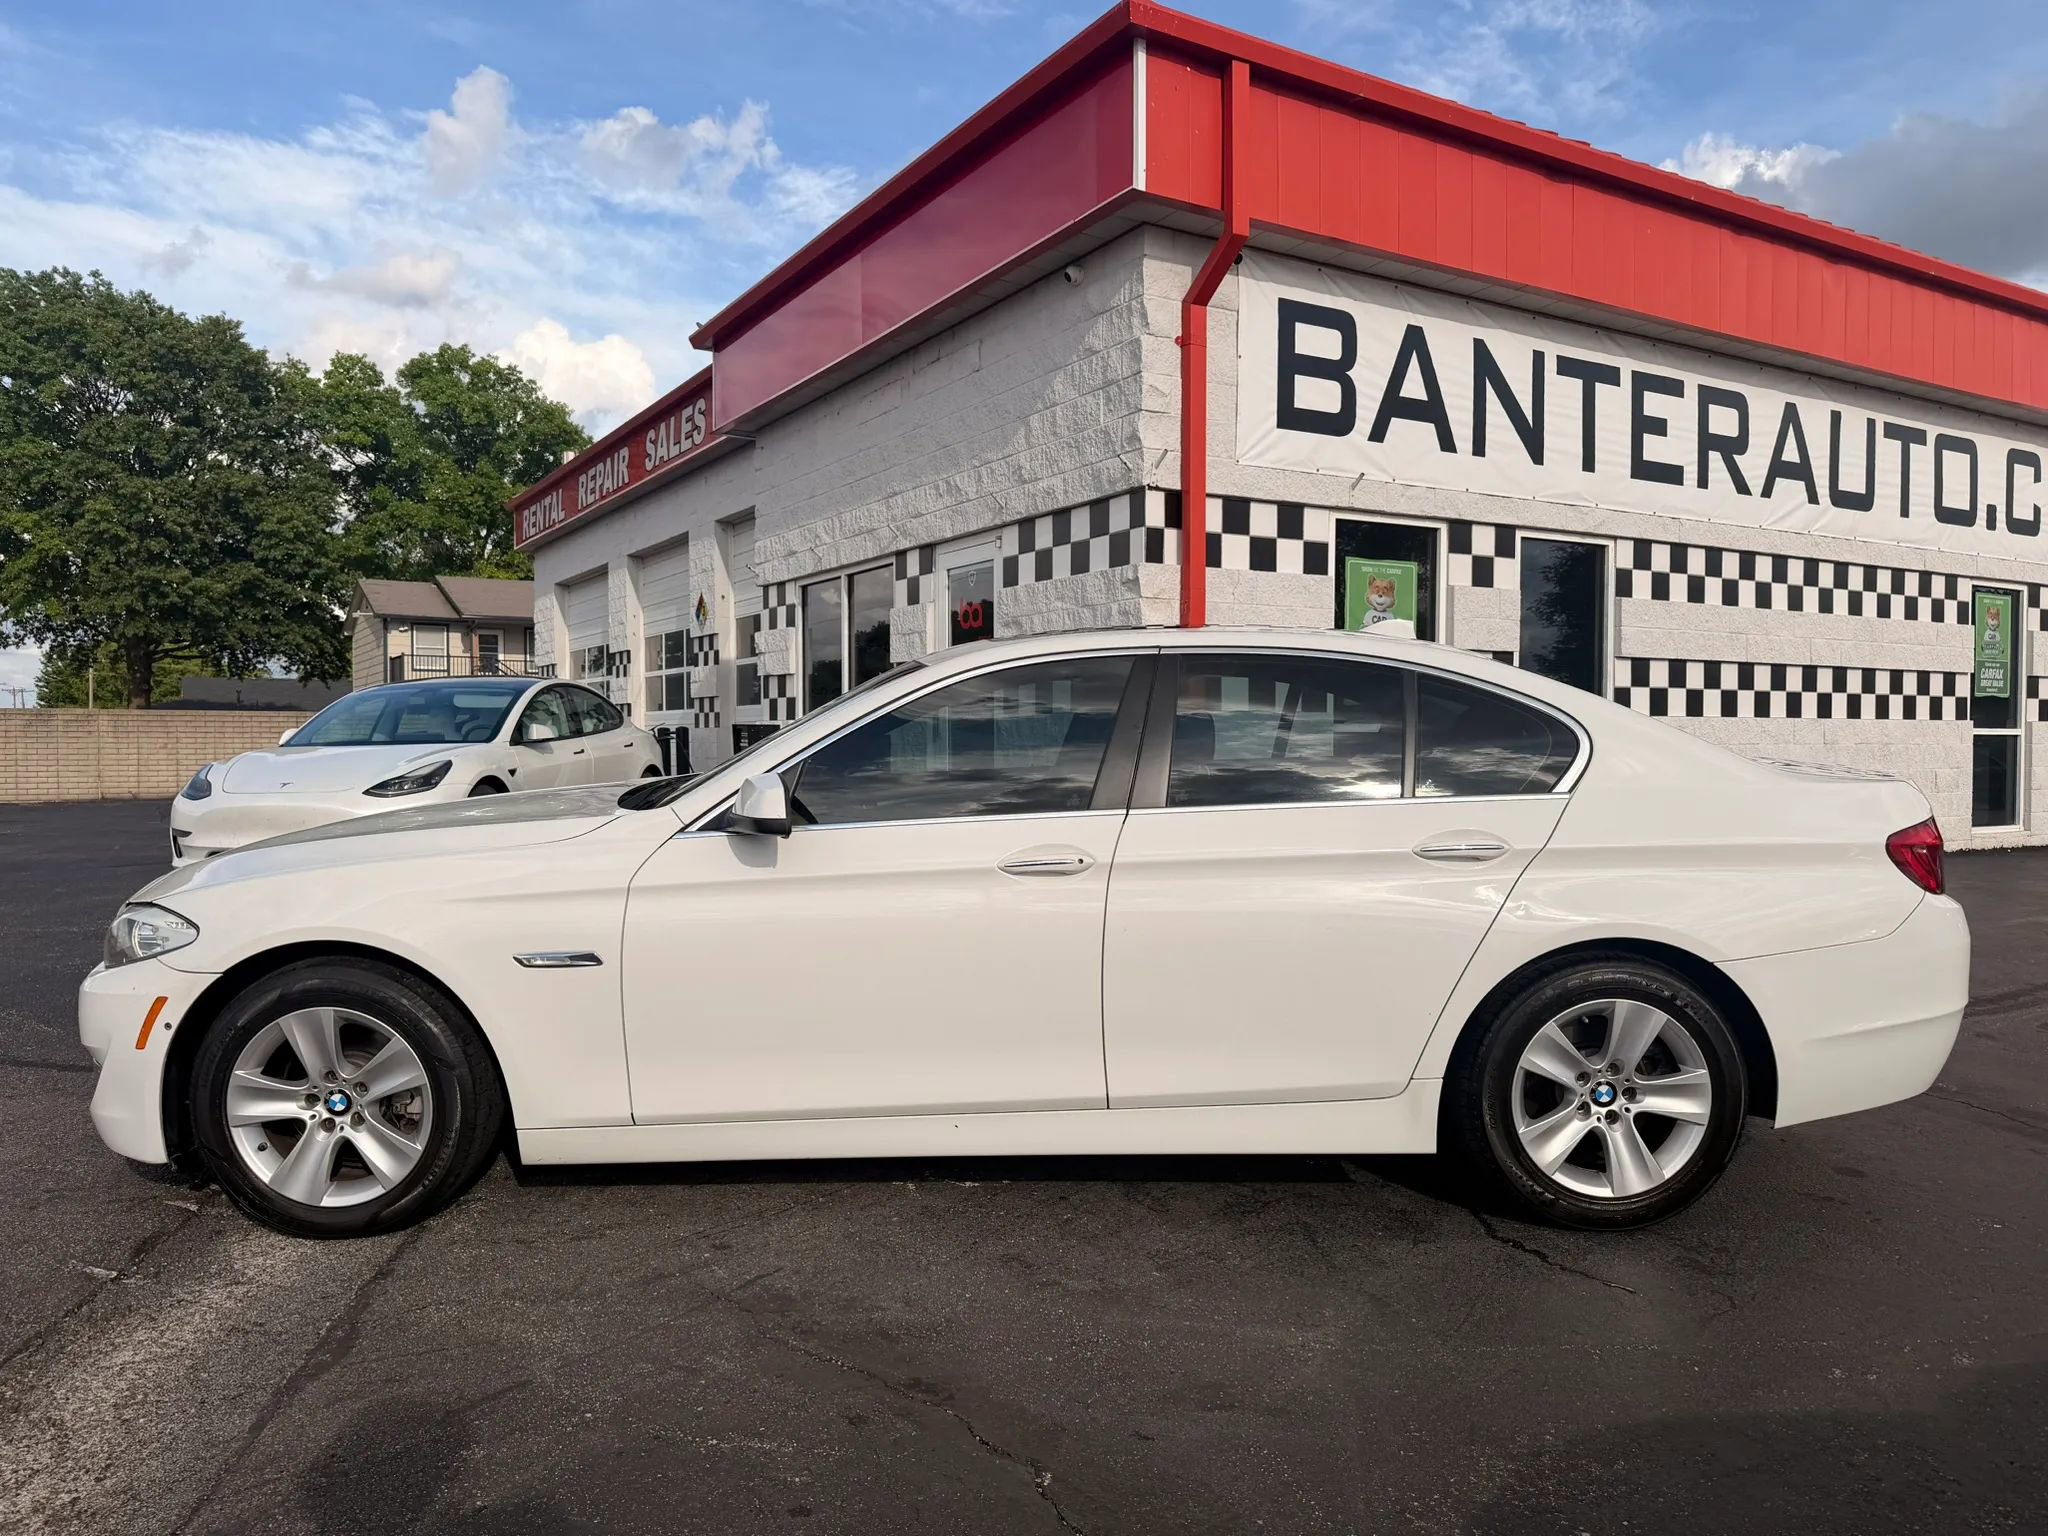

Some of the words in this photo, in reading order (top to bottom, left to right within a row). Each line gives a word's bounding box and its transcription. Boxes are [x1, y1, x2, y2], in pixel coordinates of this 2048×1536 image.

[522, 489, 566, 541] RENTAL
[578, 446, 630, 510] REPAIR
[645, 398, 706, 470] SALES
[1277, 298, 2042, 538] BANTERAUTO.C
[1980, 668, 2004, 679] CARFAX
